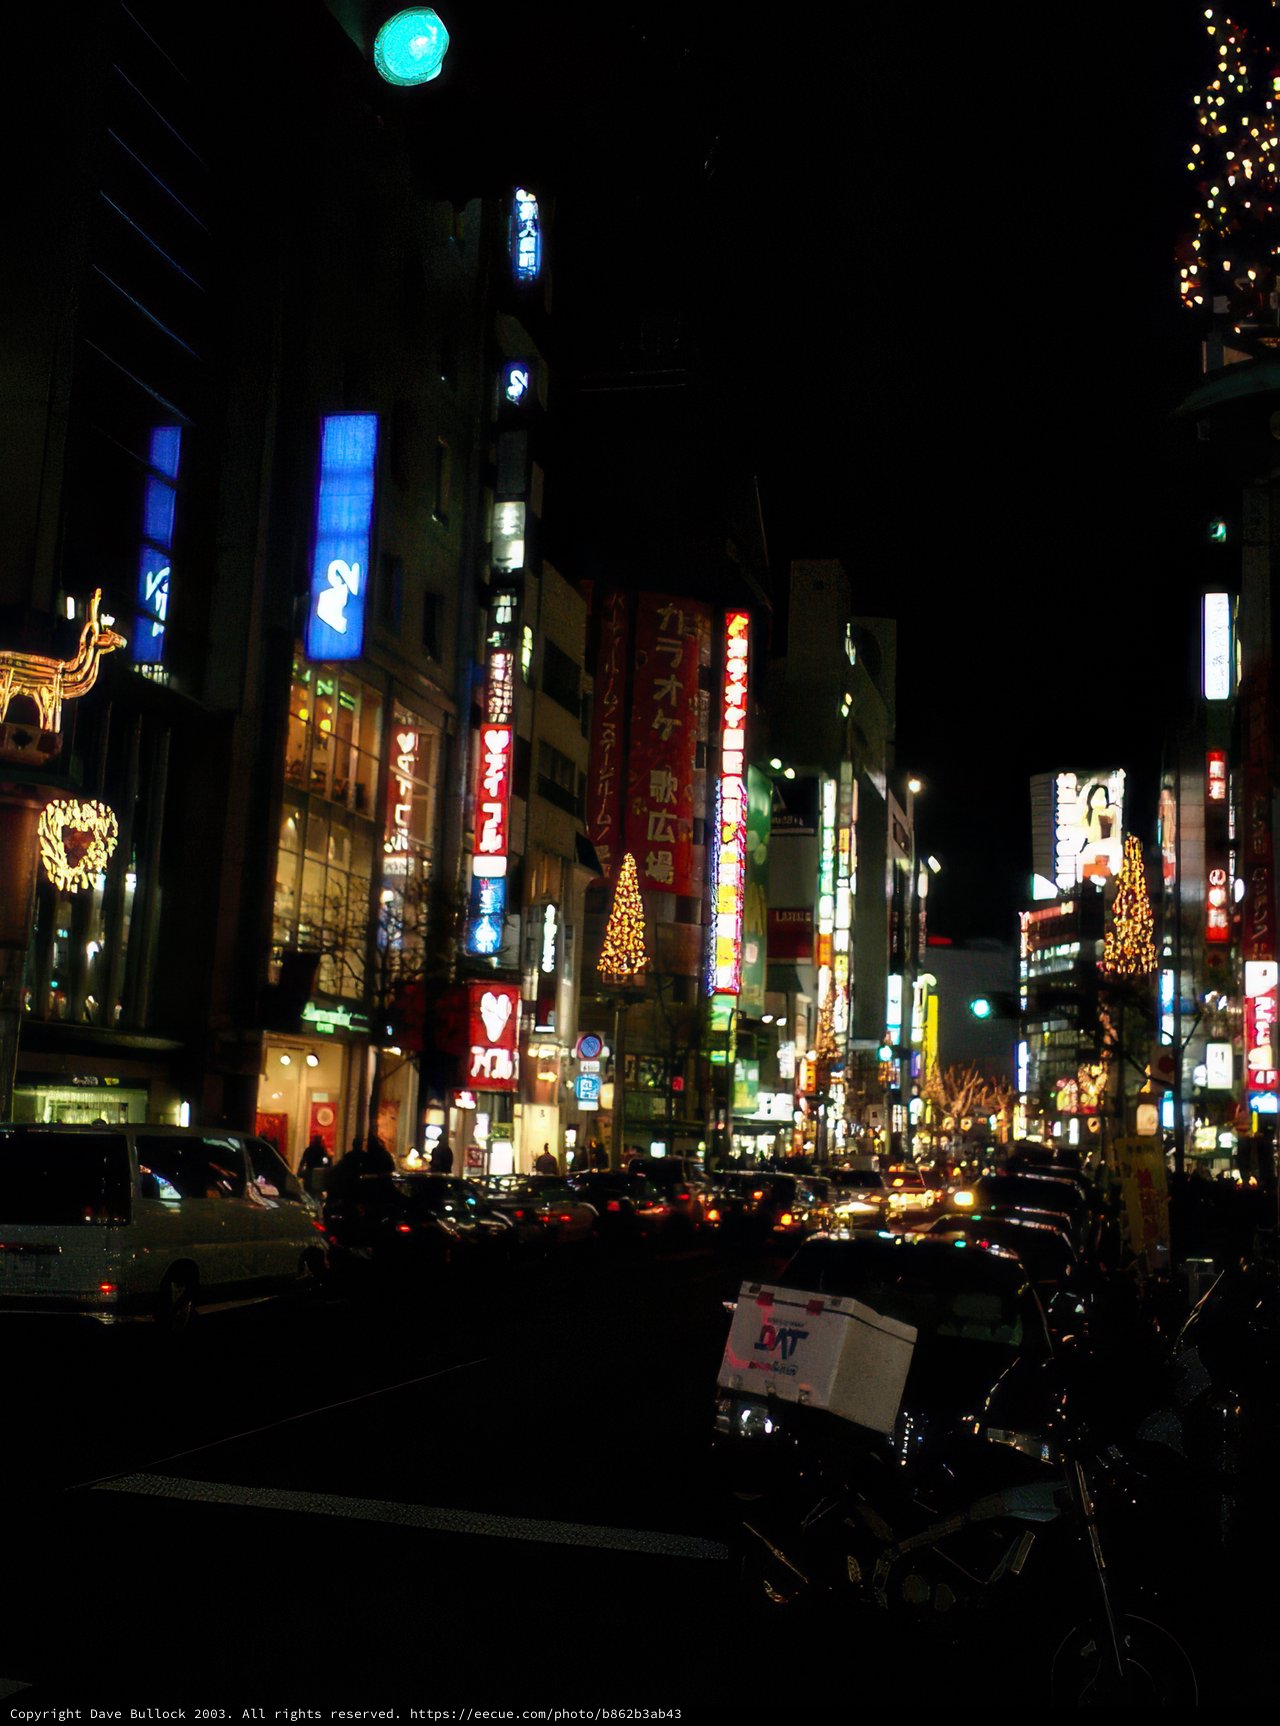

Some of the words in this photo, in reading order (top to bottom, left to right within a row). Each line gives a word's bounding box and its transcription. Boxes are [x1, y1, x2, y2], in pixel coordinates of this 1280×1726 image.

[651, 602, 684, 742] カラオケ
[644, 764, 679, 885] 歌広場
